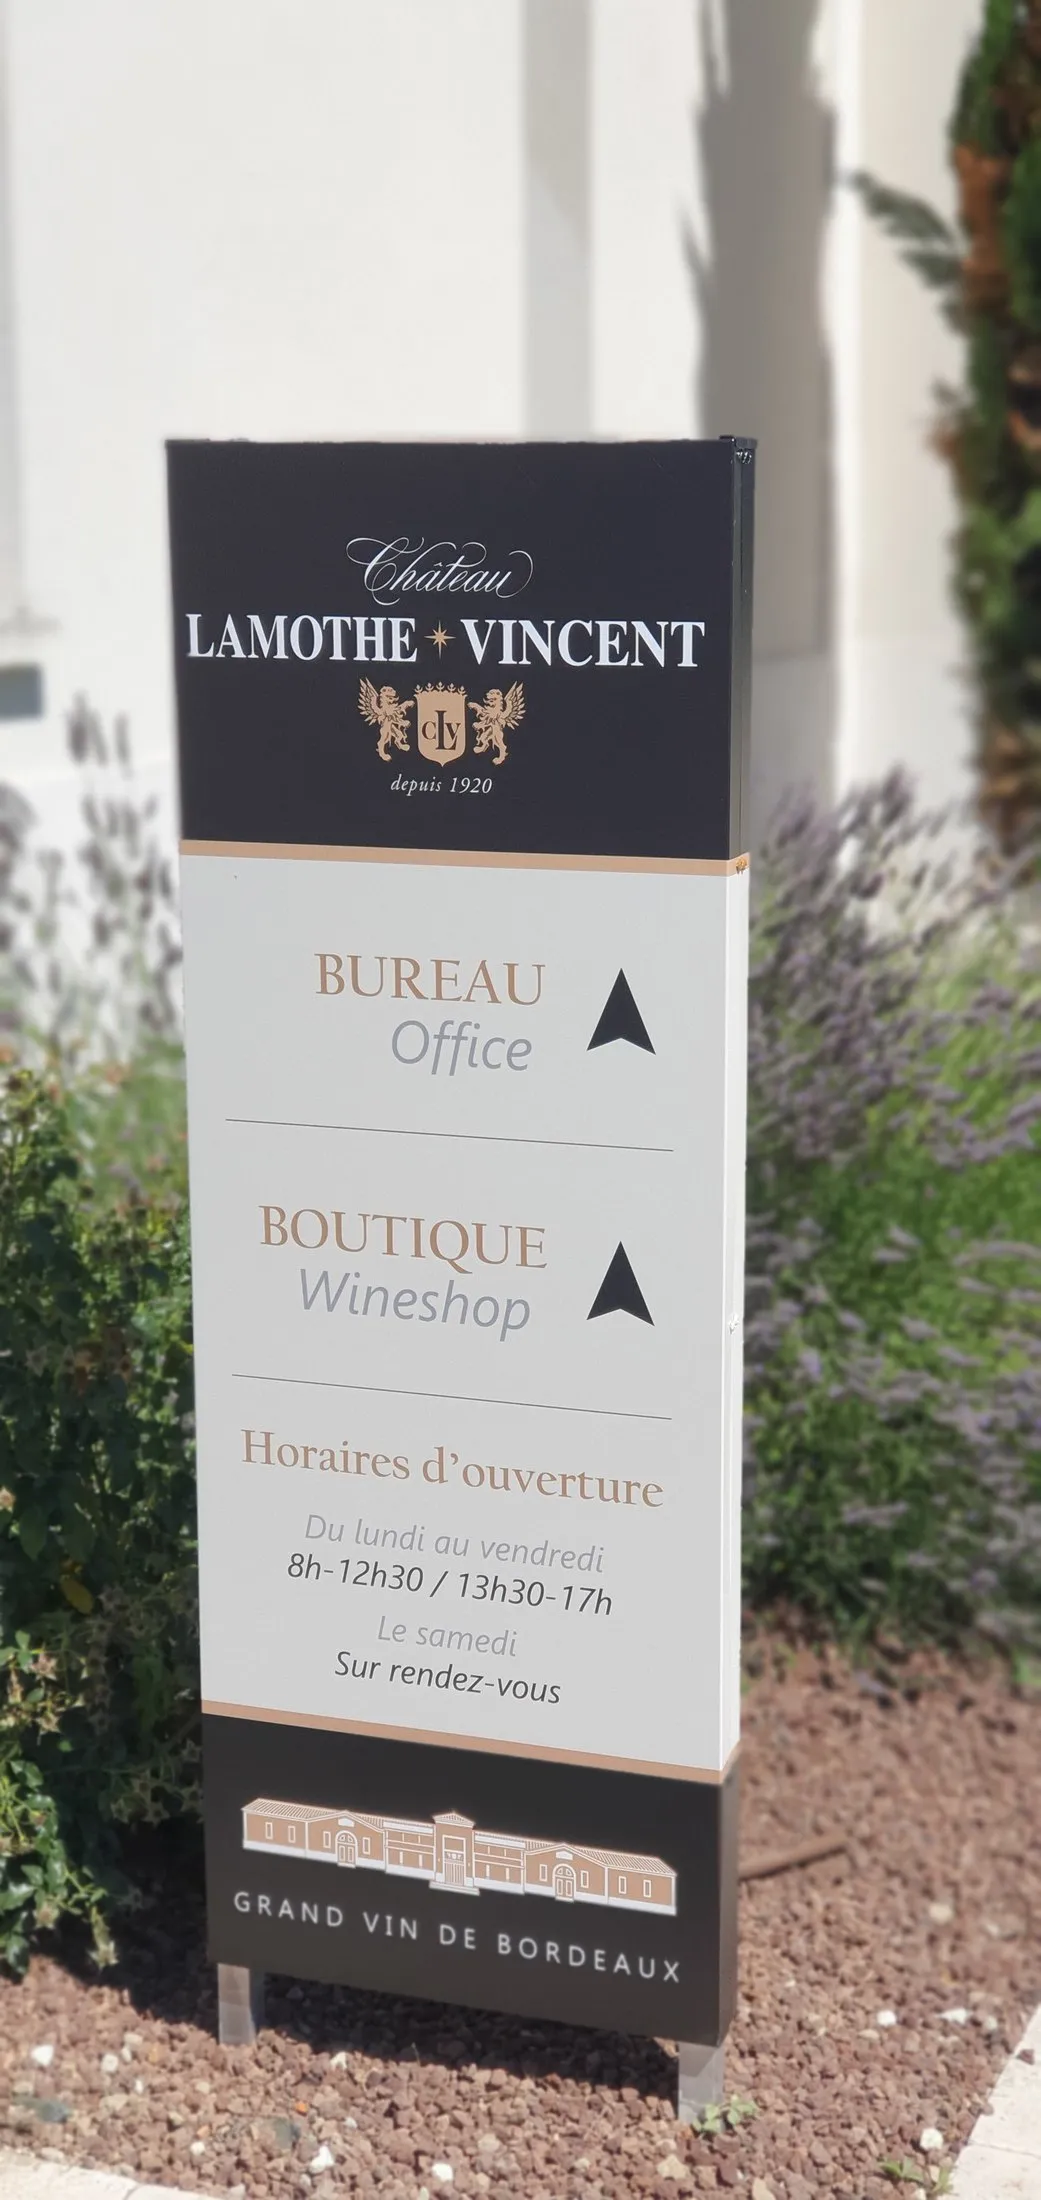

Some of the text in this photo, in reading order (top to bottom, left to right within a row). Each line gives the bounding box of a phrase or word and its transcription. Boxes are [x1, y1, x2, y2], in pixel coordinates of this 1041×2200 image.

[346, 537, 533, 606] Château
[186, 613, 706, 668] LAMOTHE VINCENT
[390, 773, 493, 796] depuis 1920
[313, 953, 546, 1006] BUREAU
[391, 1020, 533, 1077] Office
[258, 1205, 548, 1275] BOUTIQUE
[299, 1268, 531, 1342] Wineshop
[241, 1429, 411, 1481] Horaires
[304, 1514, 605, 1573] Du lundi au vendredi
[286, 1553, 613, 1616] 8h-12h30 / 13h30-17h
[377, 1615, 518, 1657] Le samedi
[334, 1651, 562, 1704] Sur rendez-vous
[233, 1891, 681, 1984] GRAND VIN DE BORDEAUX
